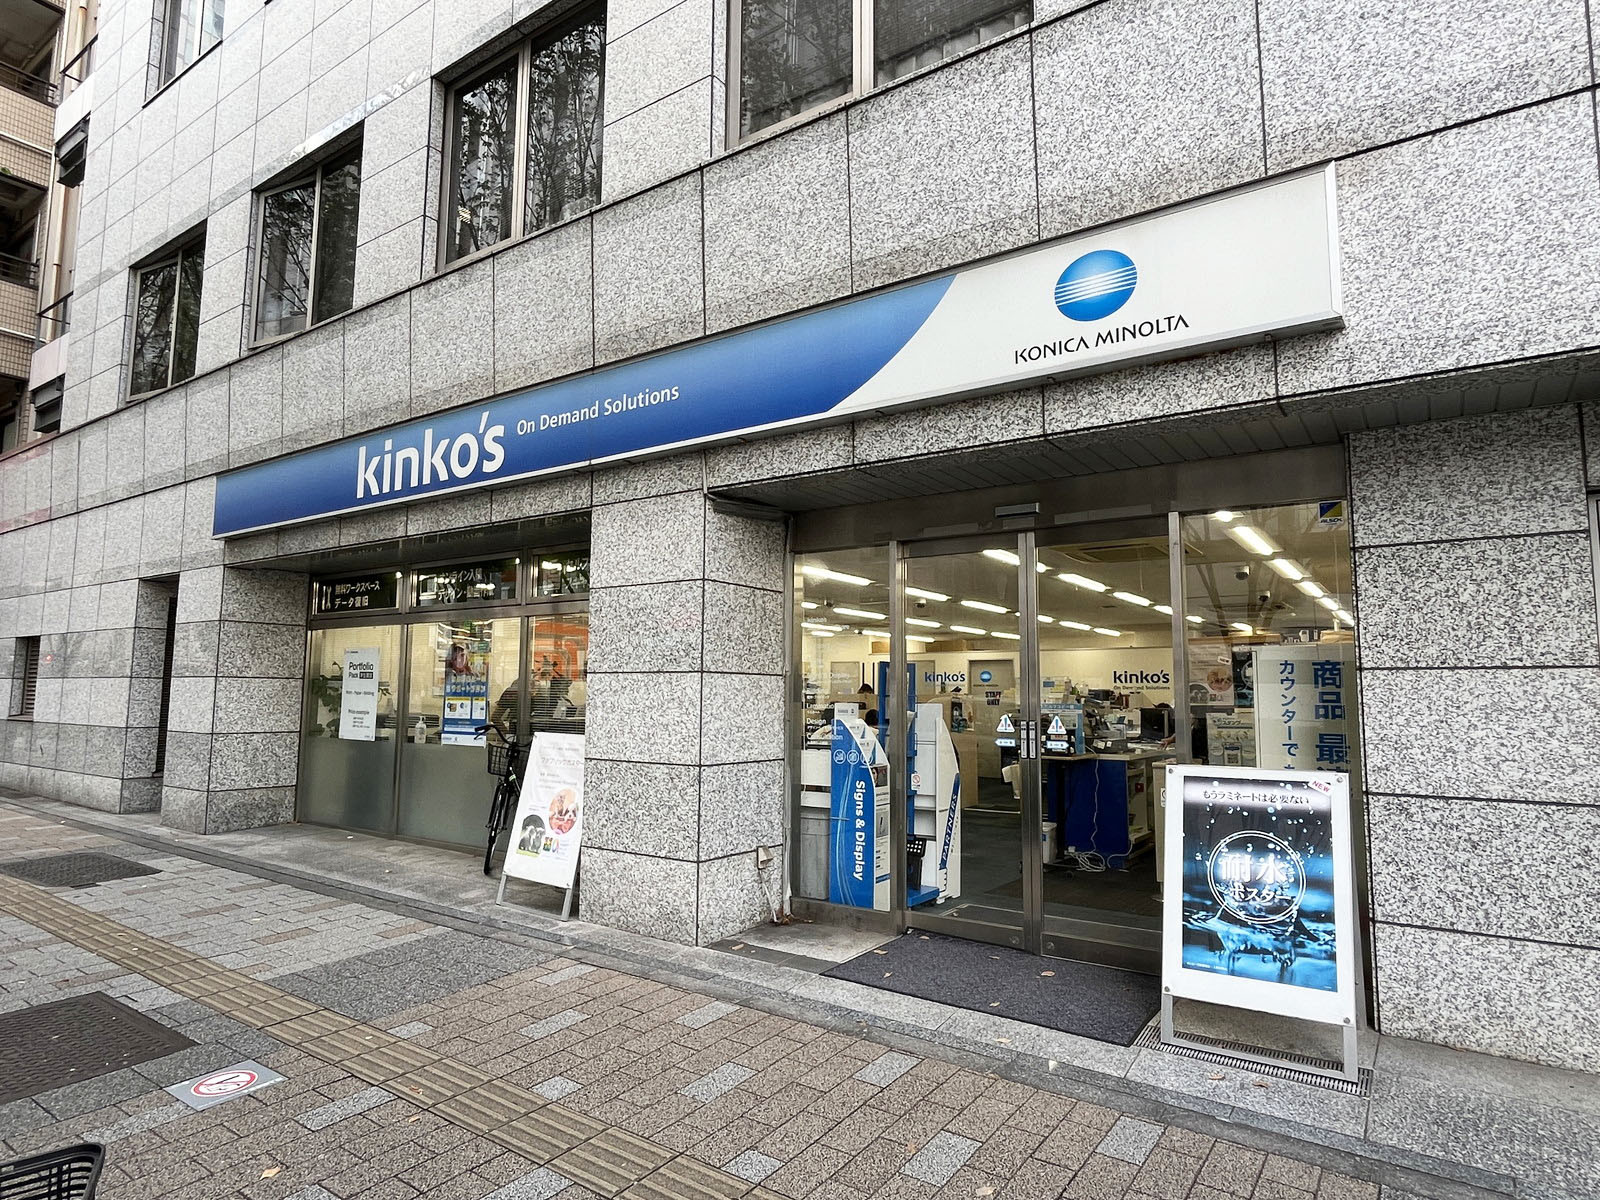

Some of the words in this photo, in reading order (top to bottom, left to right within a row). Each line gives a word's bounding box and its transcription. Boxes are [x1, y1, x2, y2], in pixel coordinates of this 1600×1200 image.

[1014, 335, 1090, 365] KONICA
[1094, 314, 1190, 348] MINOLTA
[516, 418, 535, 436] On
[540, 401, 599, 431] Demand
[603, 385, 680, 416] Solutions
[356, 411, 505, 499] kinko's
[334, 595, 369, 609] データ復旧
[348, 661, 374, 671] Portfolio
[924, 671, 966, 682] kinko's
[1113, 669, 1170, 684] kinko's
[1312, 660, 1346, 721] 商品
[806, 717, 827, 726] Design
[1311, 779, 1331, 793] NEW
[855, 780, 866, 818] Signs
[1202, 789, 1310, 805] もうラミネートは必要ない
[855, 819, 866, 830] &
[941, 793, 958, 861] PARTNERS
[853, 830, 866, 882] Display
[1219, 854, 1286, 884] 耐水
[1228, 882, 1292, 903] ポスター
